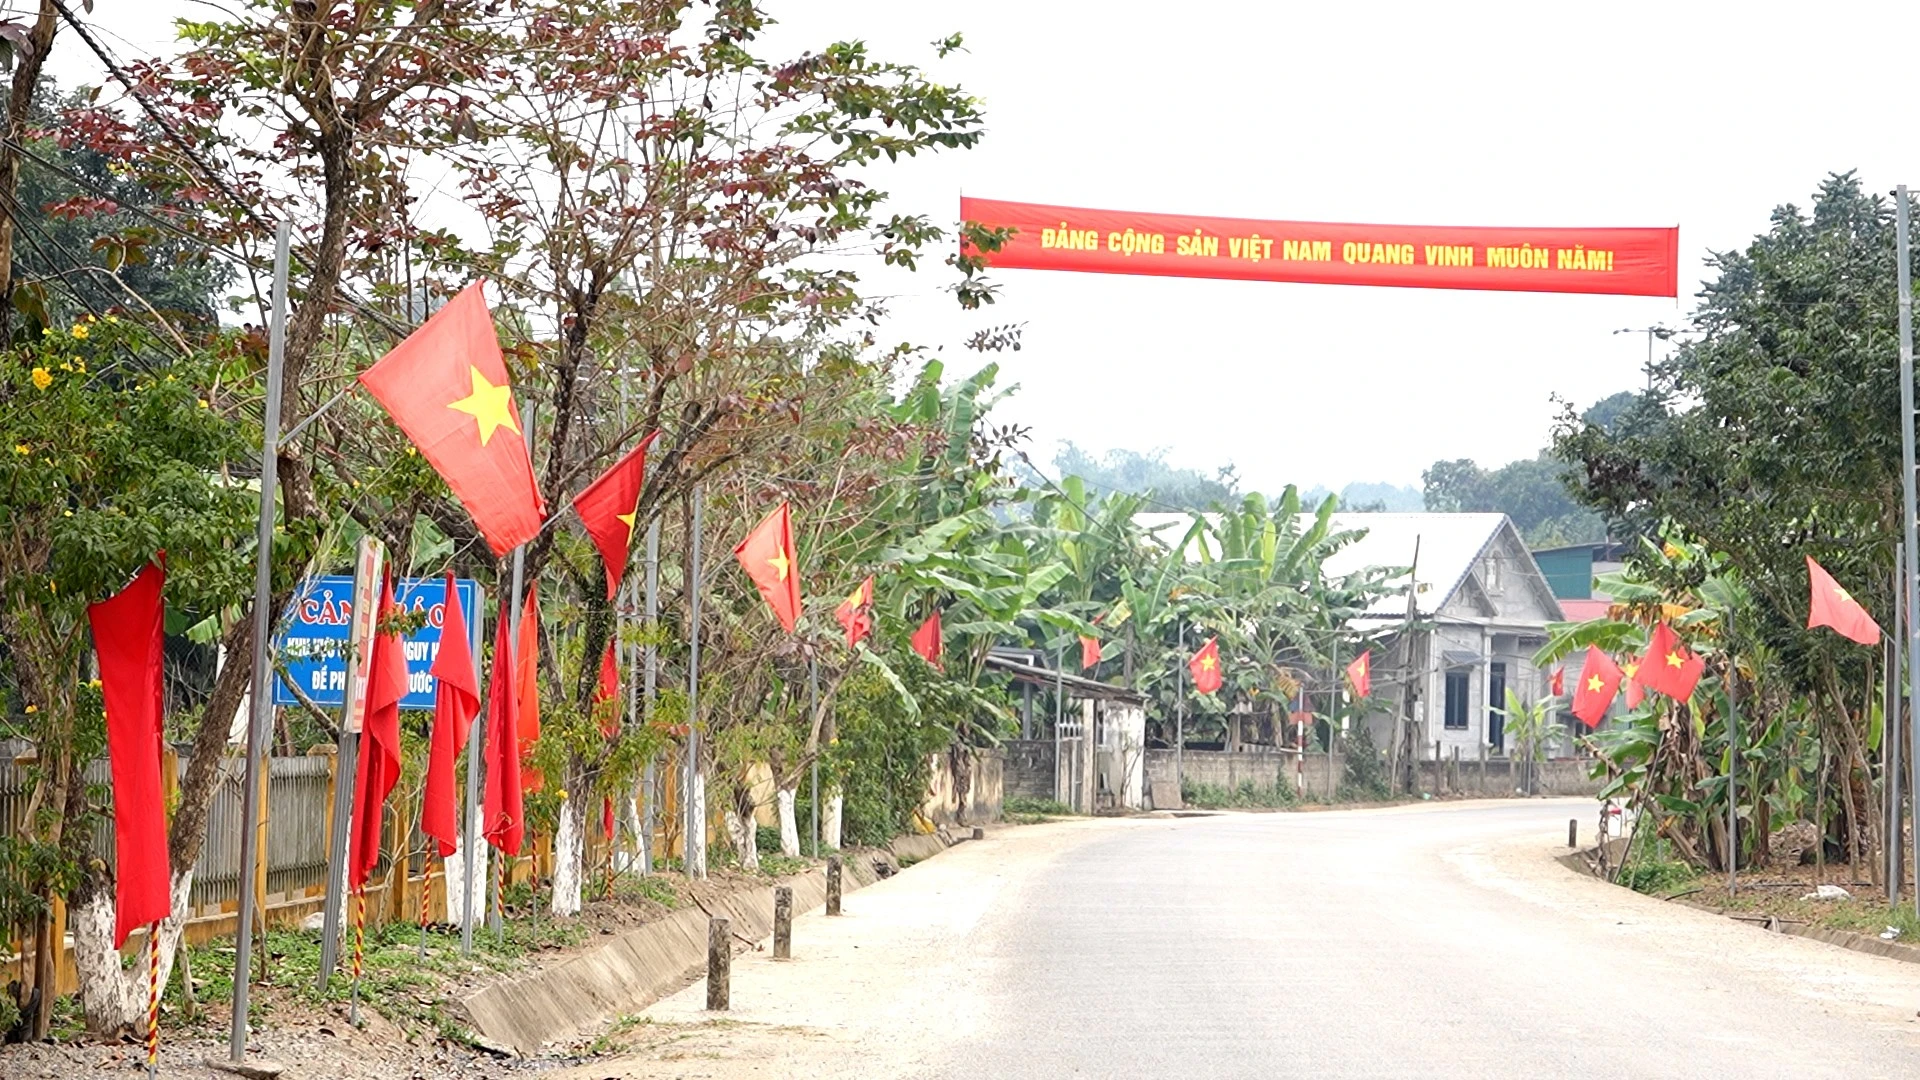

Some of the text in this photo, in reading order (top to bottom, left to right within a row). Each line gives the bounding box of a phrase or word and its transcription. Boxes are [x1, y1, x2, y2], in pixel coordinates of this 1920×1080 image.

[1041, 222, 1613, 271] ĐẢNG CỘNG SẢN VIỆT NAM QUANG VINH MUÔN NĂM!
[299, 590, 354, 626] CẢN
[408, 669, 433, 694] ƯỚC
